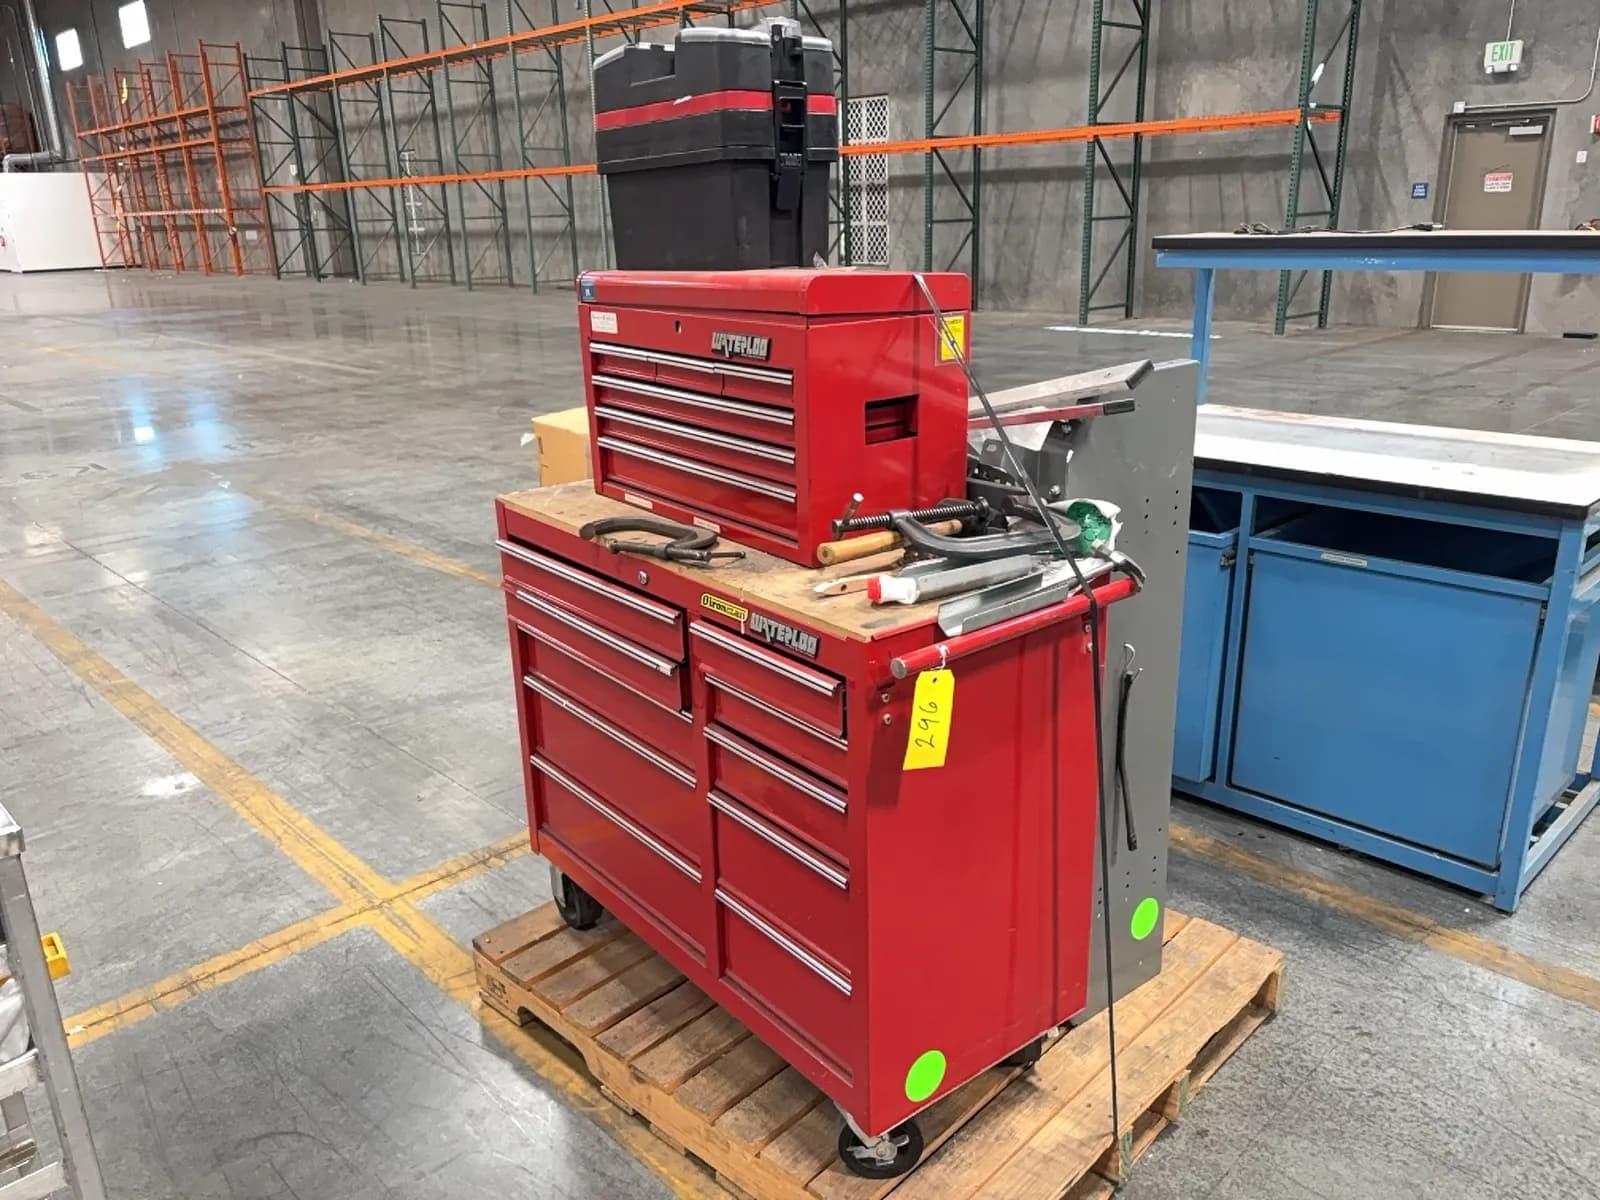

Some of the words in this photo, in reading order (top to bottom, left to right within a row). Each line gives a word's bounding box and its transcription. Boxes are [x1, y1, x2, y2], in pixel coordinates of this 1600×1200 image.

[1491, 43, 1516, 62] EXIT
[712, 332, 769, 358] WATERLOO
[750, 612, 818, 657] WATERLOO
[914, 701, 940, 748] 296
